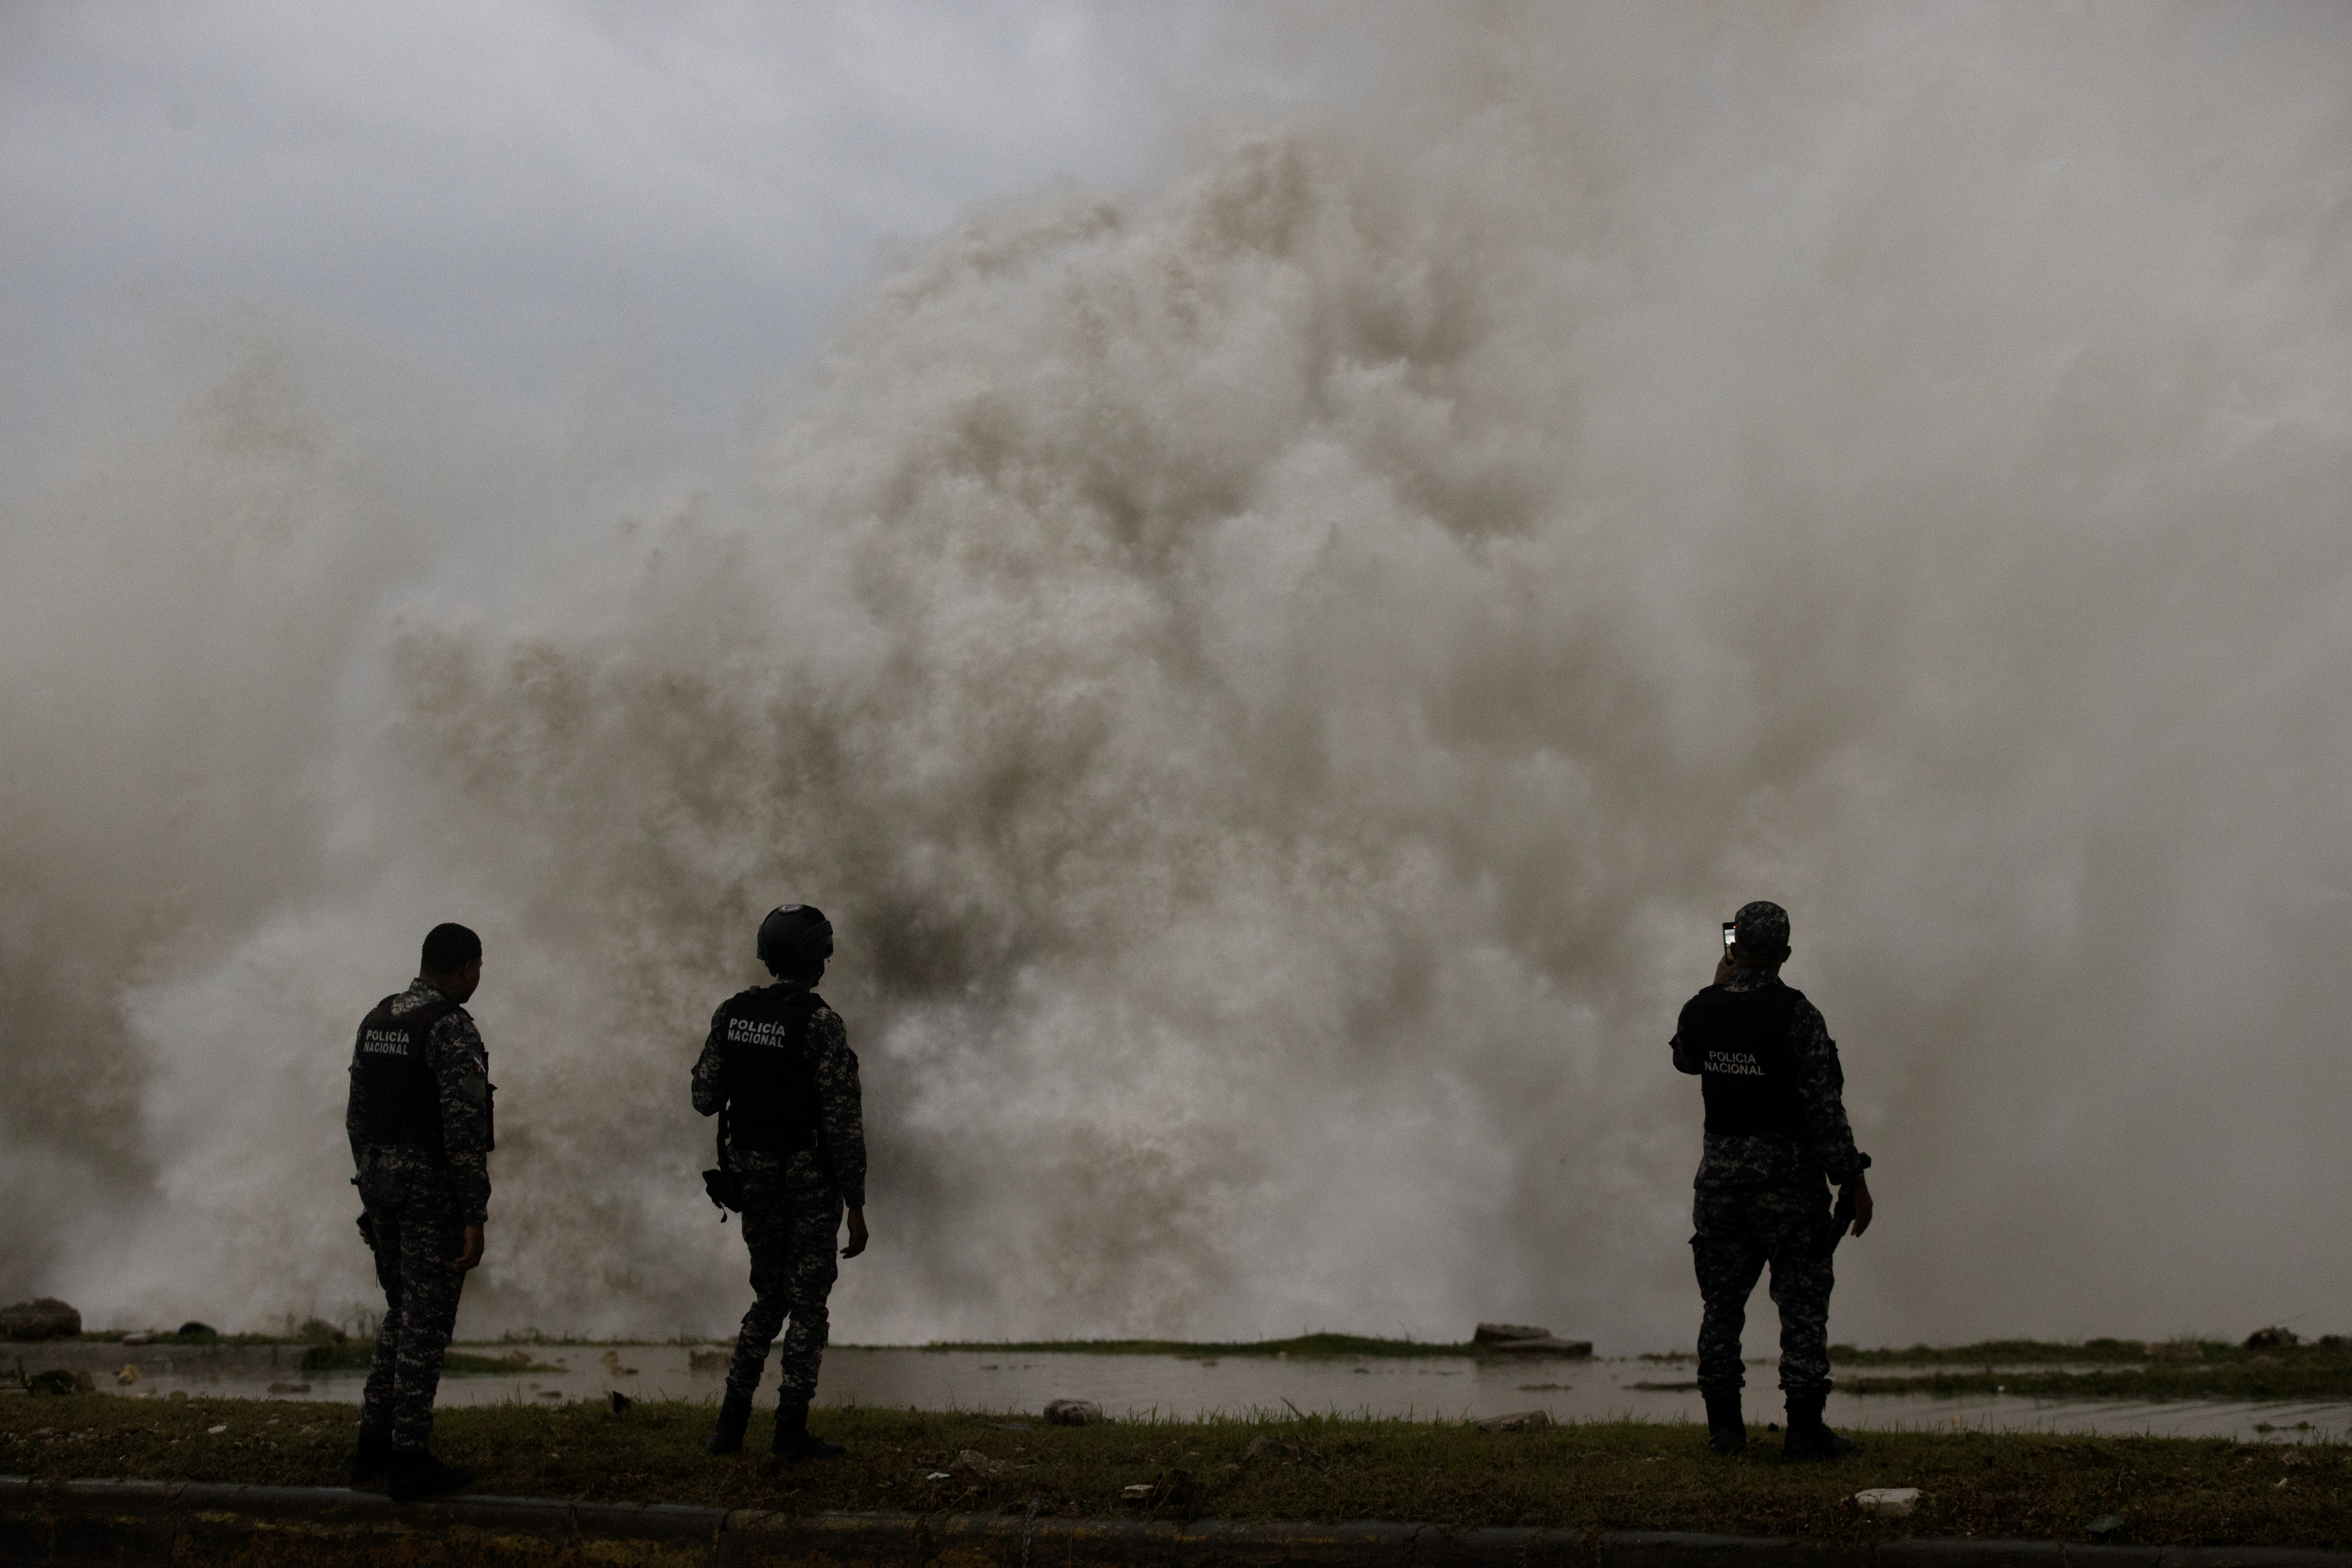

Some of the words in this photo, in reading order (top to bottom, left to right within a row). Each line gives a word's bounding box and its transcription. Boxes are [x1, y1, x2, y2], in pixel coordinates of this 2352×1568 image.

[729, 1018, 785, 1036] POLICÍA
[366, 1029, 410, 1043] POLICÍA
[727, 1029, 784, 1048] NACIONAL
[363, 1041, 408, 1055] NACIONAL
[1709, 1051, 1756, 1064] POLICIA
[1704, 1060, 1766, 1075] NACIONAL
